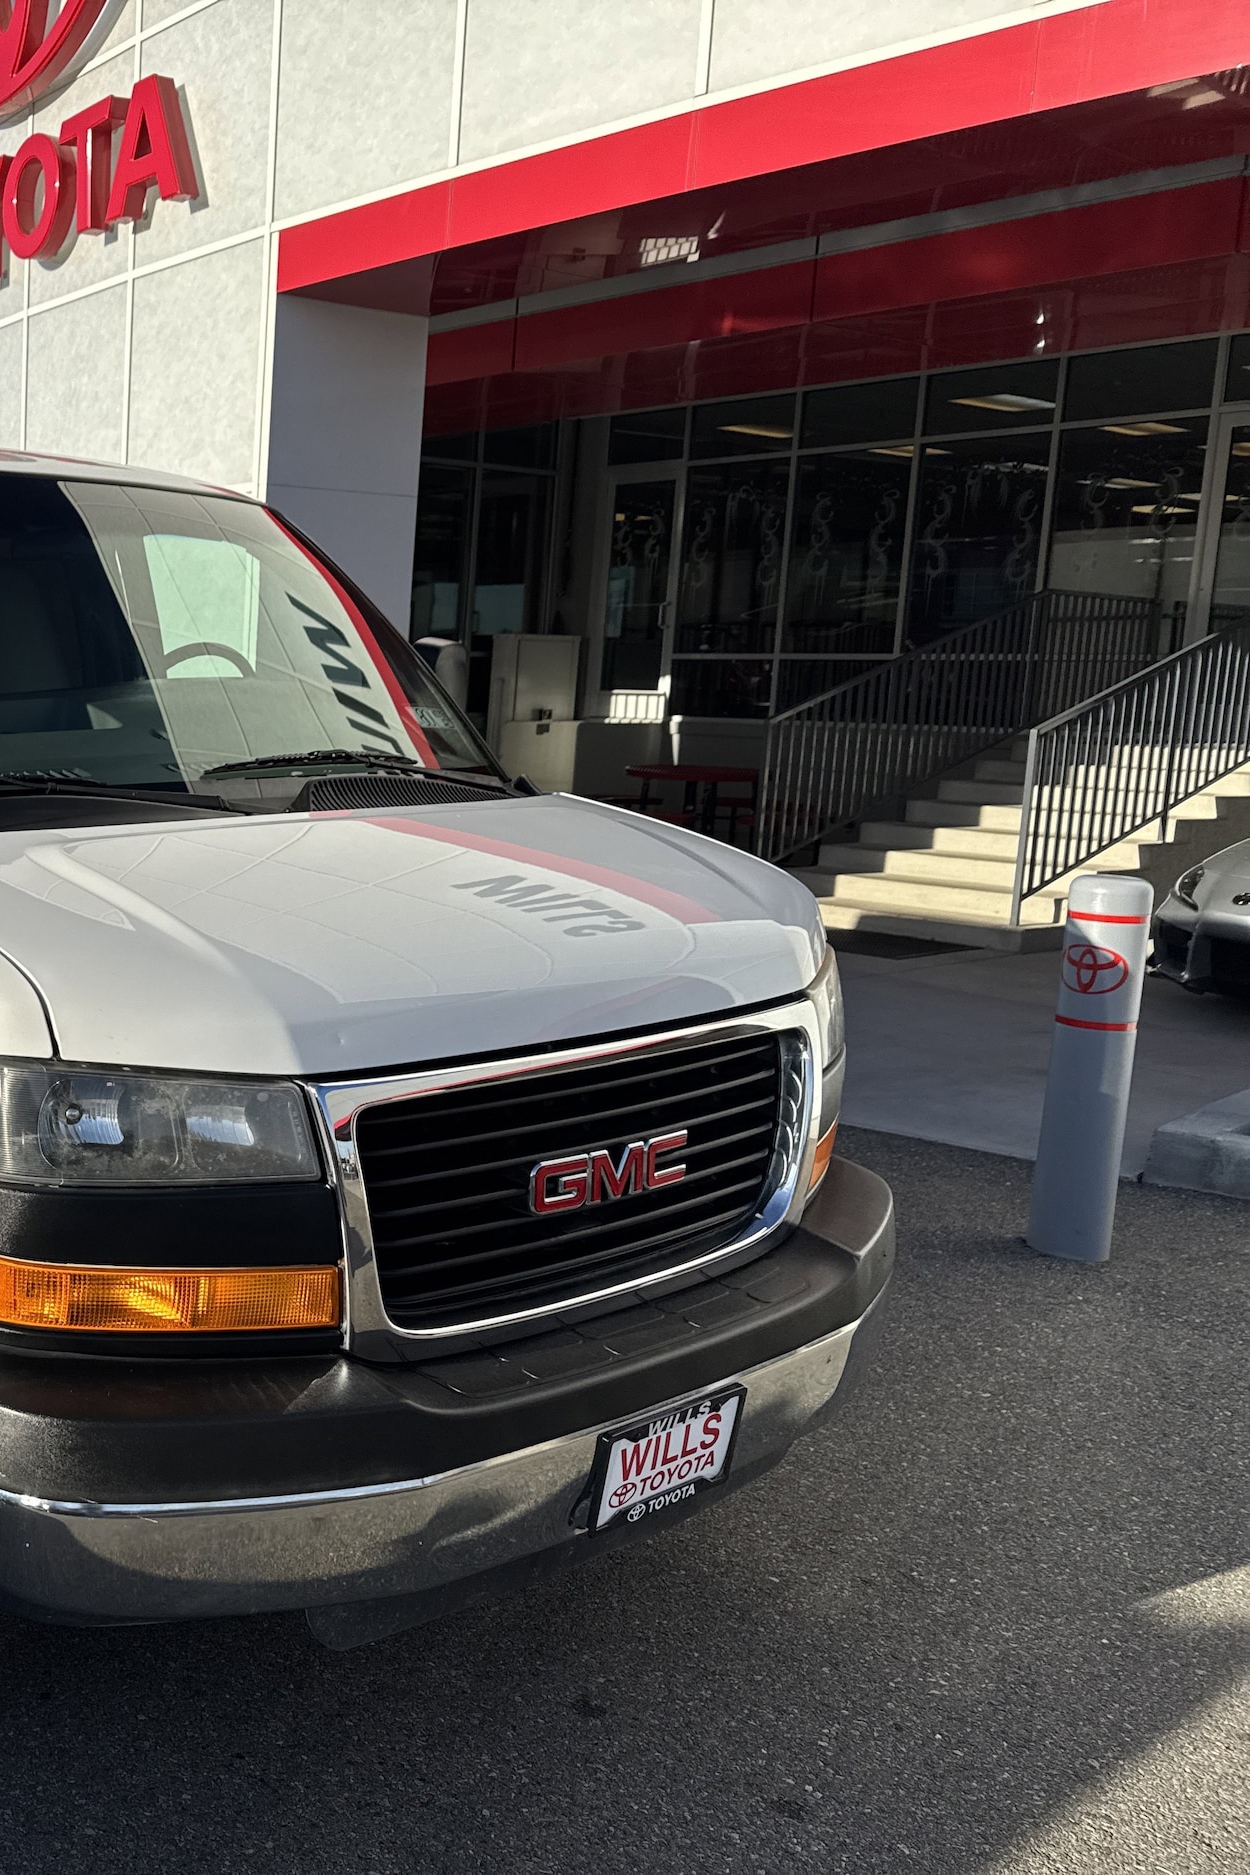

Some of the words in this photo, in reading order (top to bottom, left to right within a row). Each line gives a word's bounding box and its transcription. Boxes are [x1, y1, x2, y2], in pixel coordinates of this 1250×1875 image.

[529, 1129, 688, 1215] GMC
[649, 1400, 712, 1437] WILLS
[620, 1413, 722, 1482] WILLS
[639, 1450, 715, 1496] TOYOTA
[648, 1483, 696, 1513] TOYOTA
